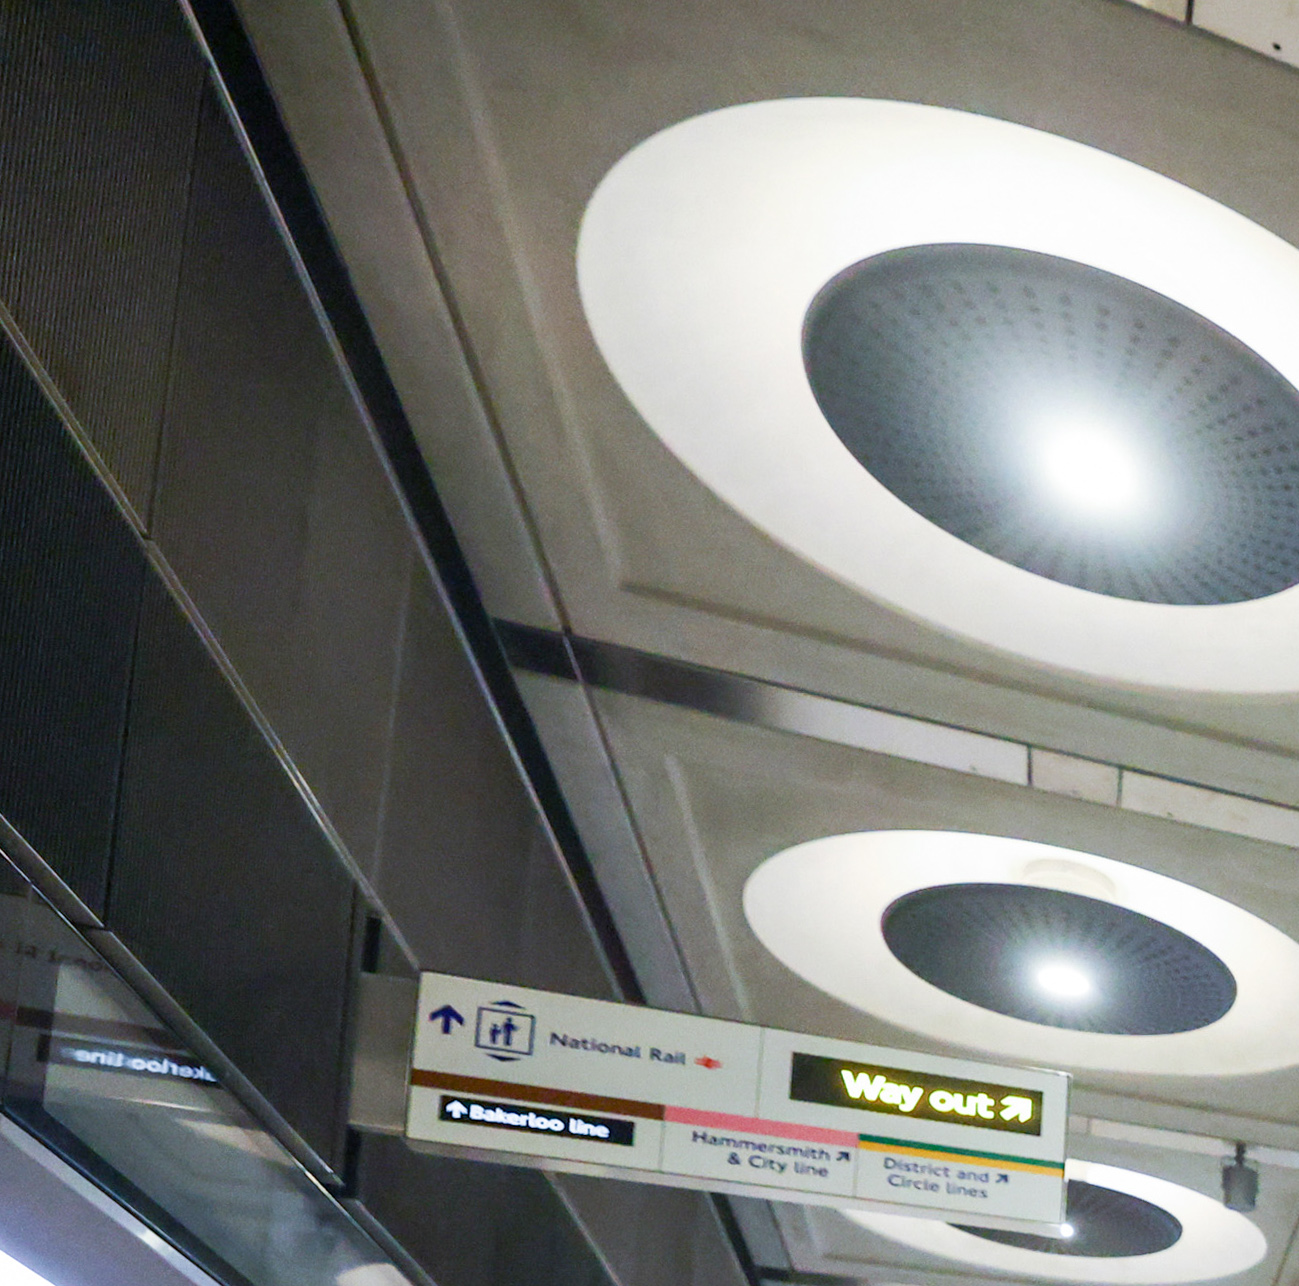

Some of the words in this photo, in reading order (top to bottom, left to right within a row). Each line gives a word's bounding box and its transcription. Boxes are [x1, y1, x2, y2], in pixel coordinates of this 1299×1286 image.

[550, 1032, 641, 1058] National
[649, 1047, 687, 1065] Rail
[841, 1069, 924, 1112] Way
[929, 1088, 995, 1119] out
[469, 1105, 564, 1131] Bakerloo
[569, 1119, 610, 1138] line
[691, 1130, 830, 1161] Hammersmith
[727, 1151, 741, 1166] &
[748, 1155, 787, 1174] City
[794, 1161, 830, 1178] line
[883, 1156, 950, 1180] District
[956, 1168, 990, 1184] and
[887, 1174, 940, 1194] Circle
[946, 1181, 989, 1199] lines
